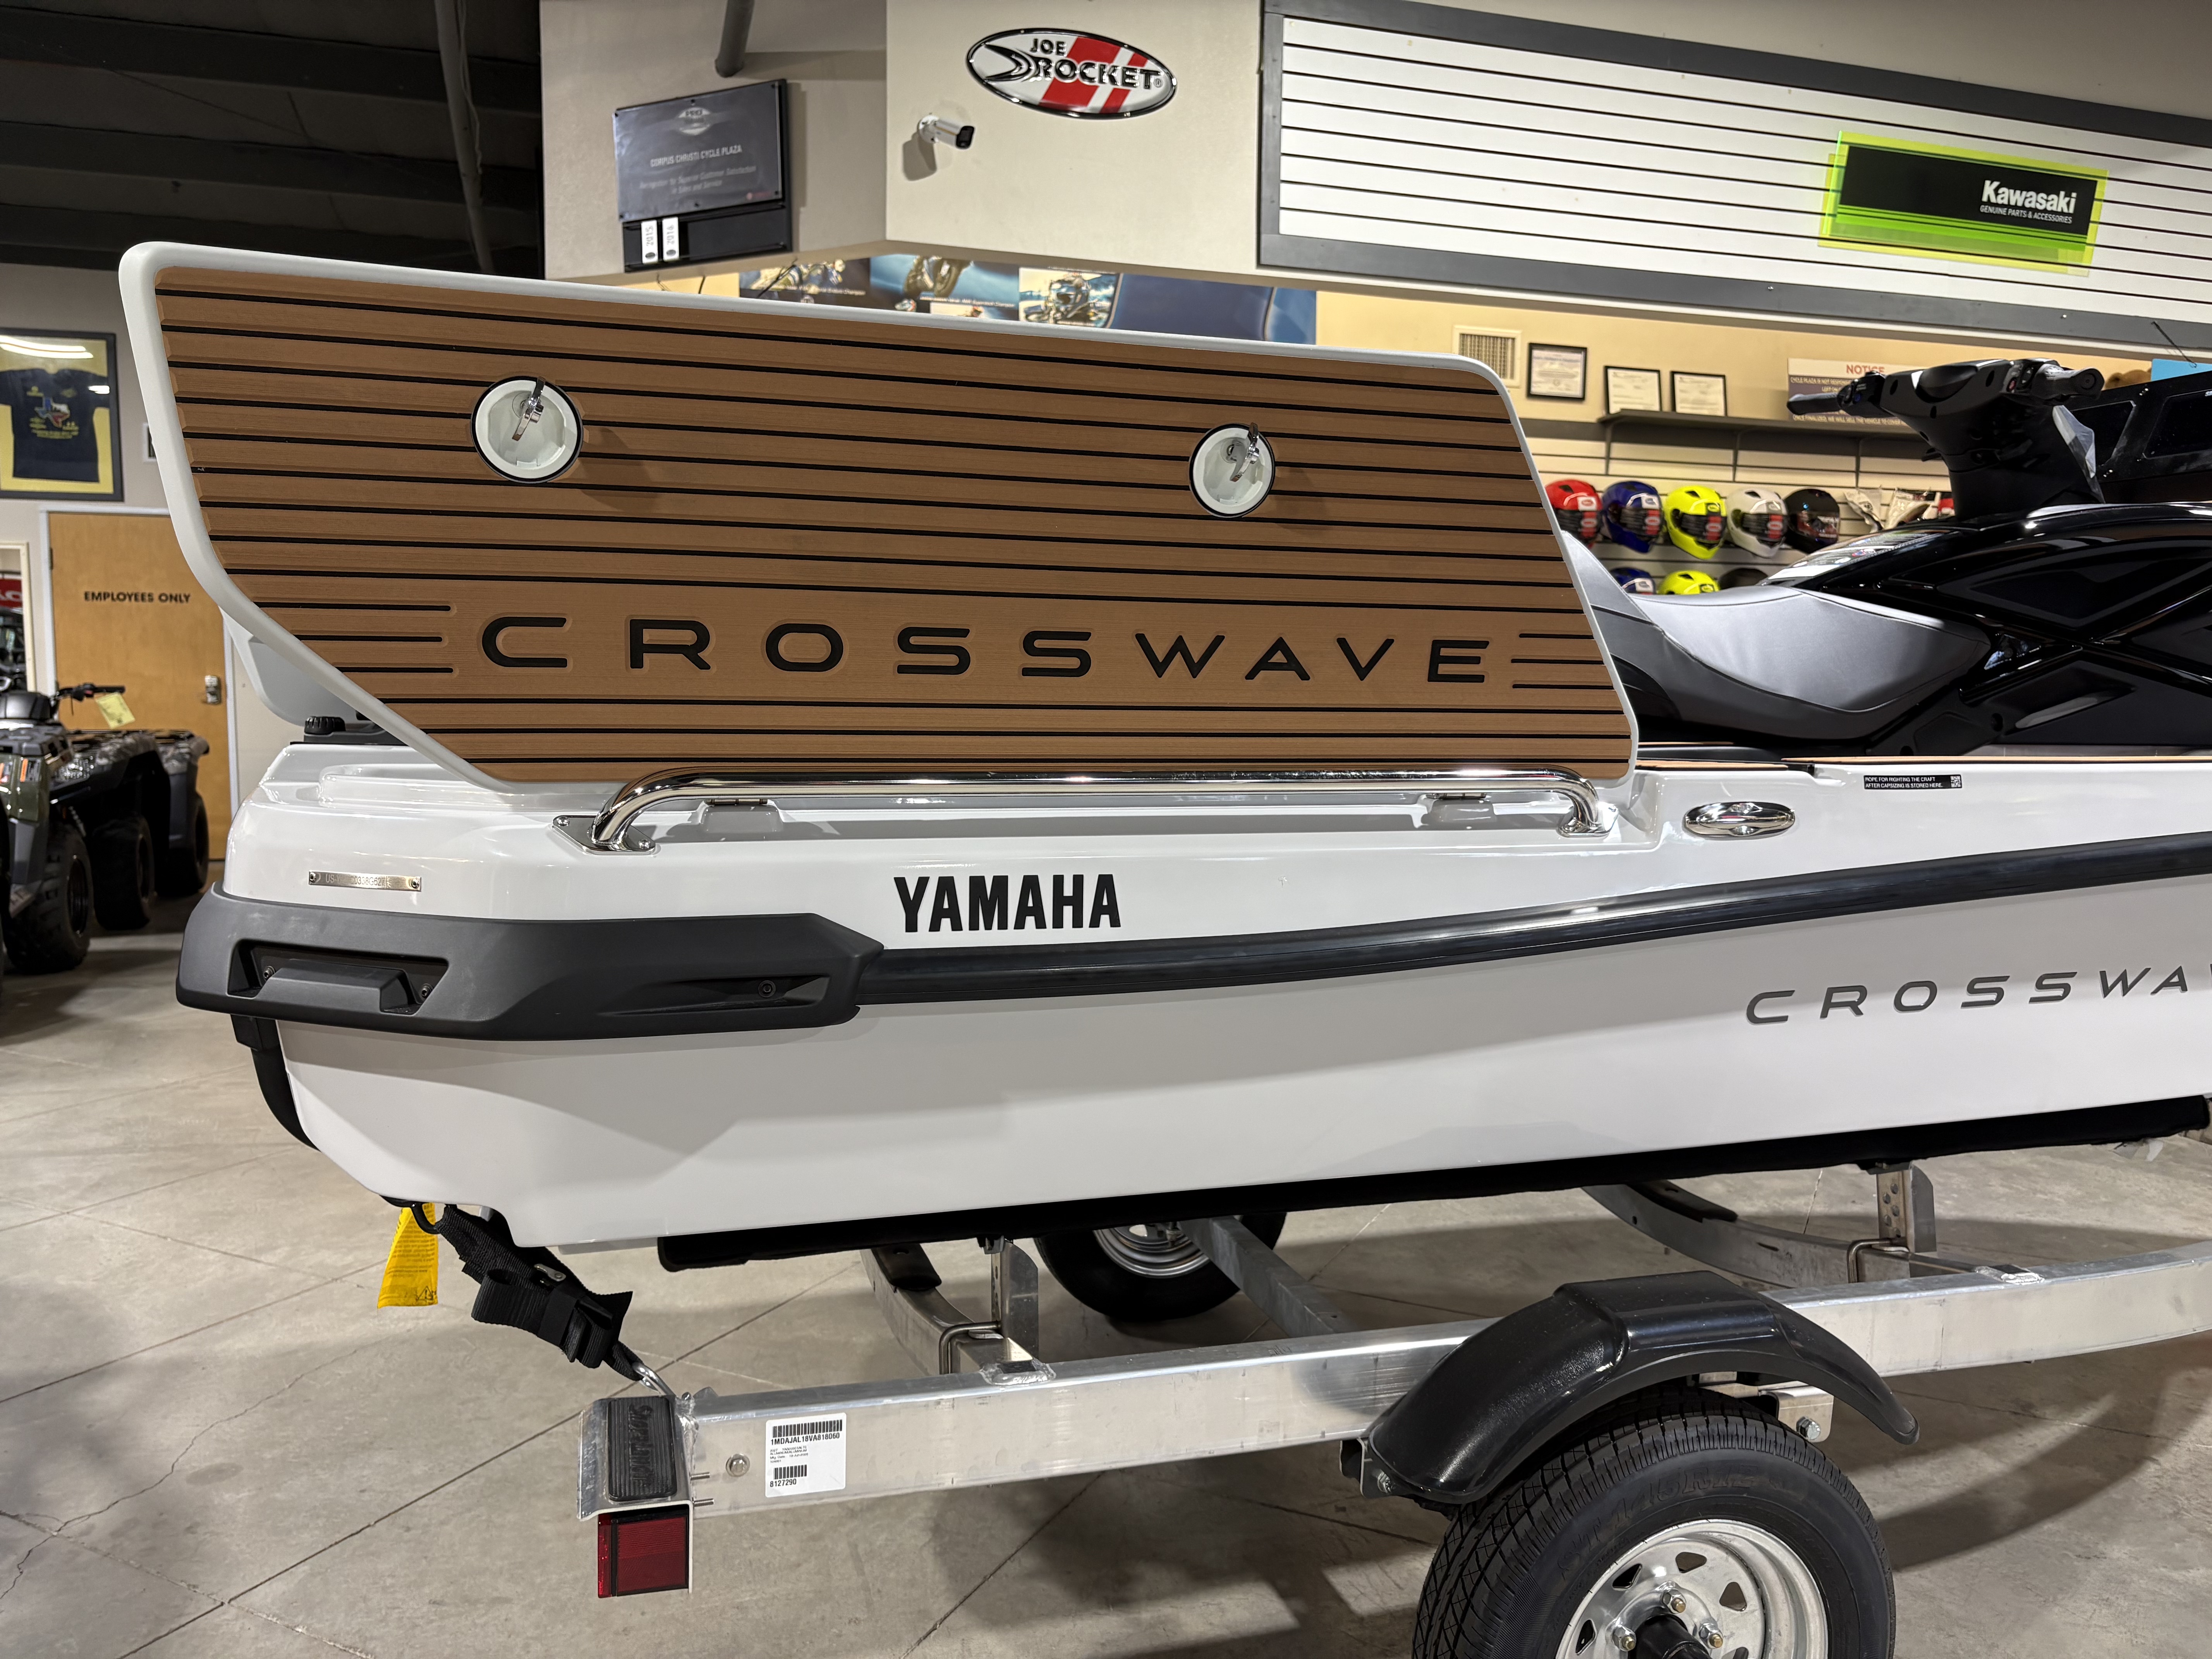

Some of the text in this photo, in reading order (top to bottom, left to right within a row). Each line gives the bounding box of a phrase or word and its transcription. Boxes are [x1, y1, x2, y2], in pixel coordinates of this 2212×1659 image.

[1030, 38, 1066, 57] JOE
[650, 144, 742, 167] CORPUS CHRISTI CYCLE PLAZA
[1981, 180, 2077, 213] Kawasaki
[1980, 205, 2008, 216] GENUINE
[2008, 208, 2027, 218] PARTS
[2033, 213, 2073, 224] ACCESSORIES
[84, 591, 191, 604] EMPLOYEES ONLY
[481, 617, 1489, 683] CROSSWAVE
[893, 874, 1121, 933] YAMAHA
[1746, 964, 2212, 1025] CROSSWA
[771, 1432, 840, 1445] 1MDAJAL18VA818060
[770, 1478, 797, 1487] 8127290
